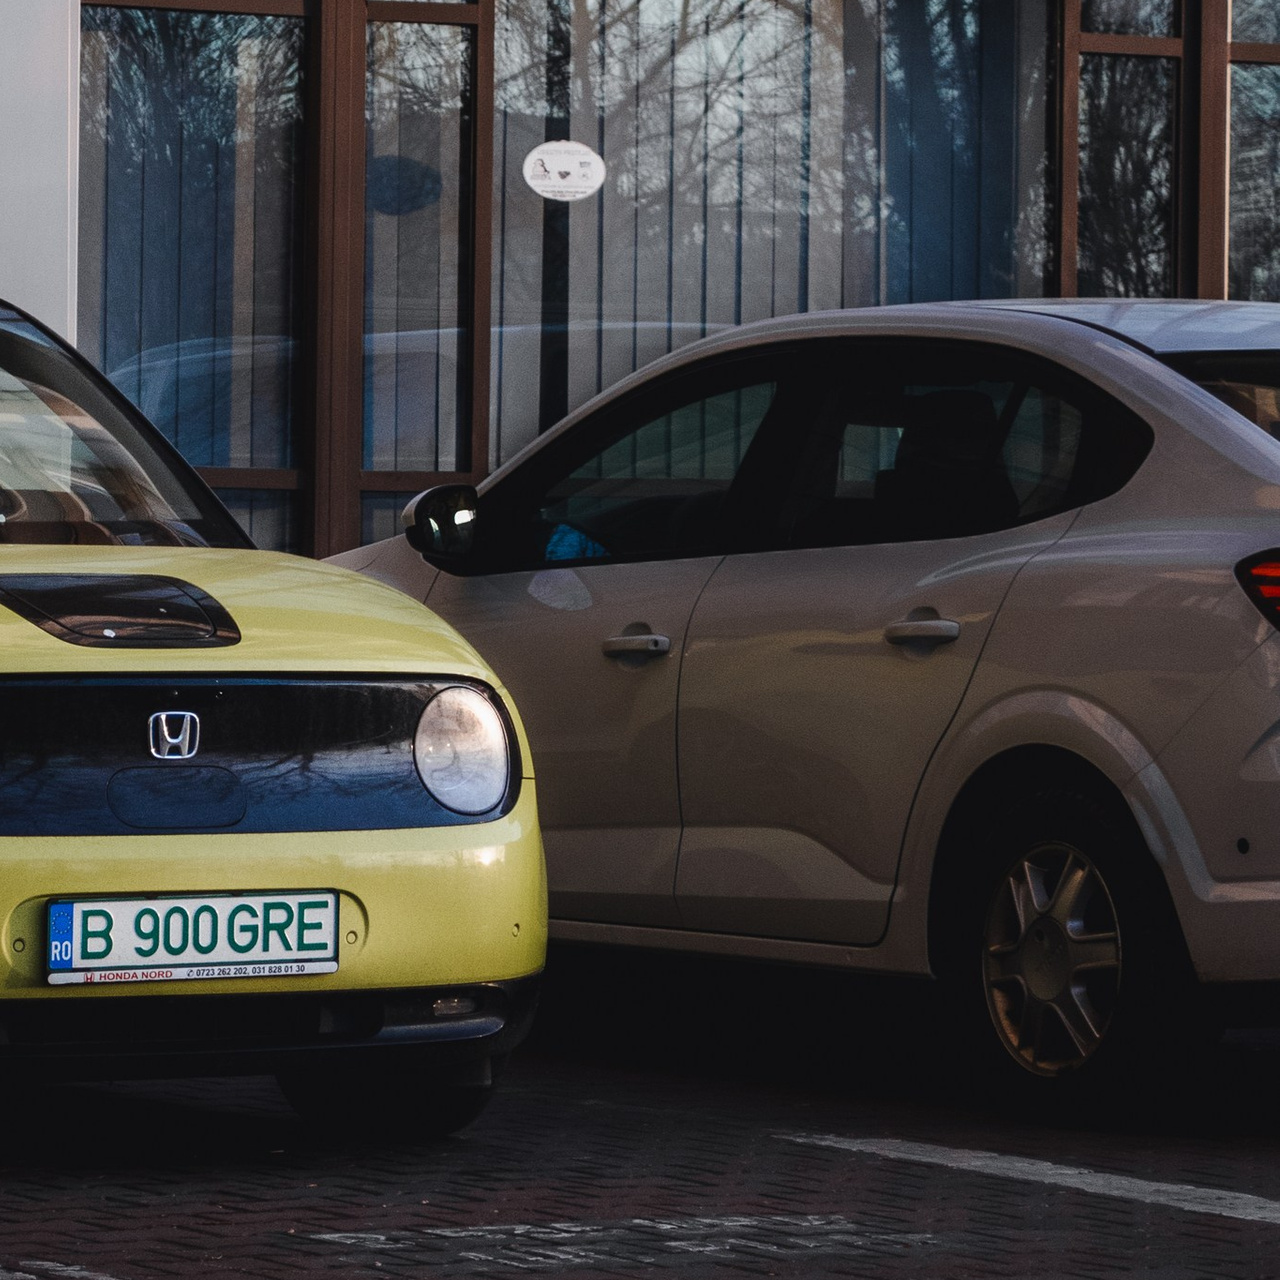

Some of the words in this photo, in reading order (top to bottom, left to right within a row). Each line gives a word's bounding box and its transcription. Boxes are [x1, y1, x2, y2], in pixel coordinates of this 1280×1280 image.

[80, 909, 114, 960] B
[51, 940, 72, 962] RO
[98, 970, 139, 982] HONDA
[141, 968, 173, 980] NORD
[195, 966, 216, 977] 0723
